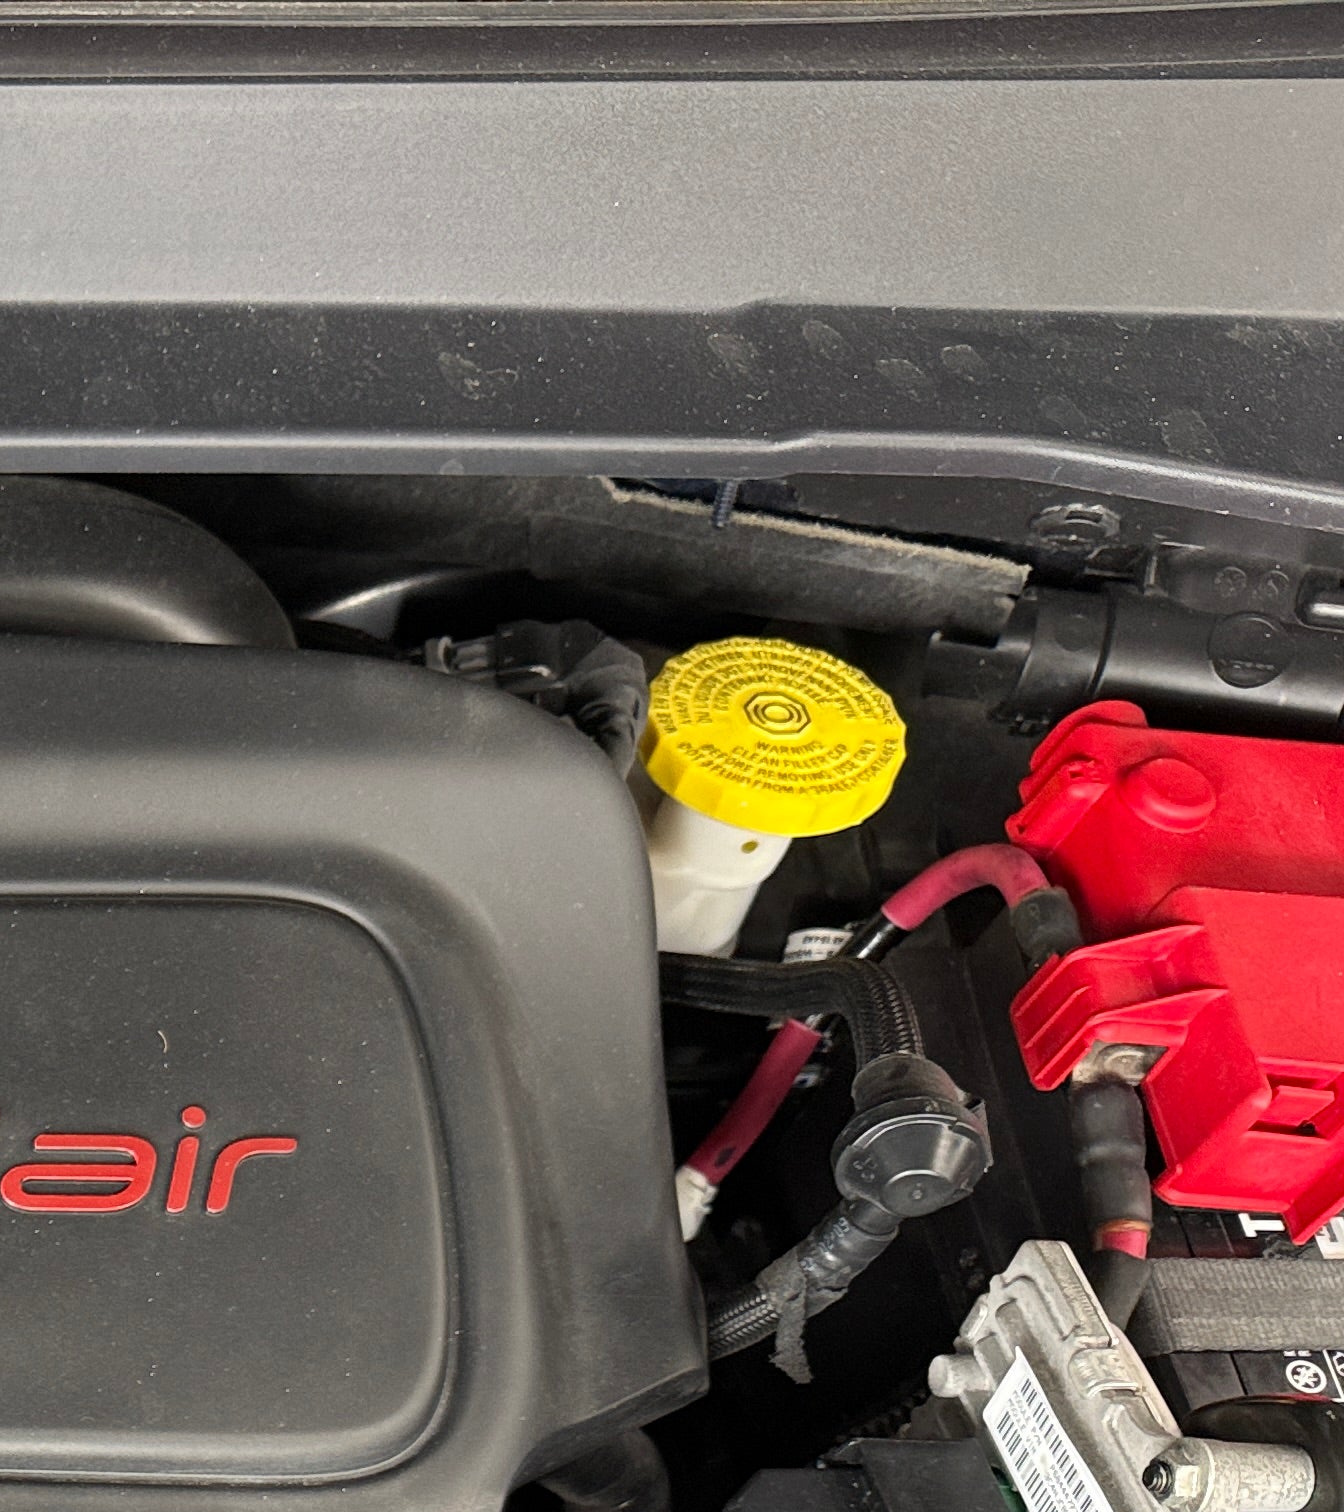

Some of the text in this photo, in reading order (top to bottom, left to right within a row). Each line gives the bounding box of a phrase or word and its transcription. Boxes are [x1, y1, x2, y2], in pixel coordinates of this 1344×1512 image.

[732, 743, 848, 769] CLEAN FILLER CAP
[756, 741, 824, 755] WARNING
[1011, 1389, 1031, 1425] MODULE
[1007, 1396, 1026, 1434] MODULE
[1025, 1433, 1037, 1456] VIN
